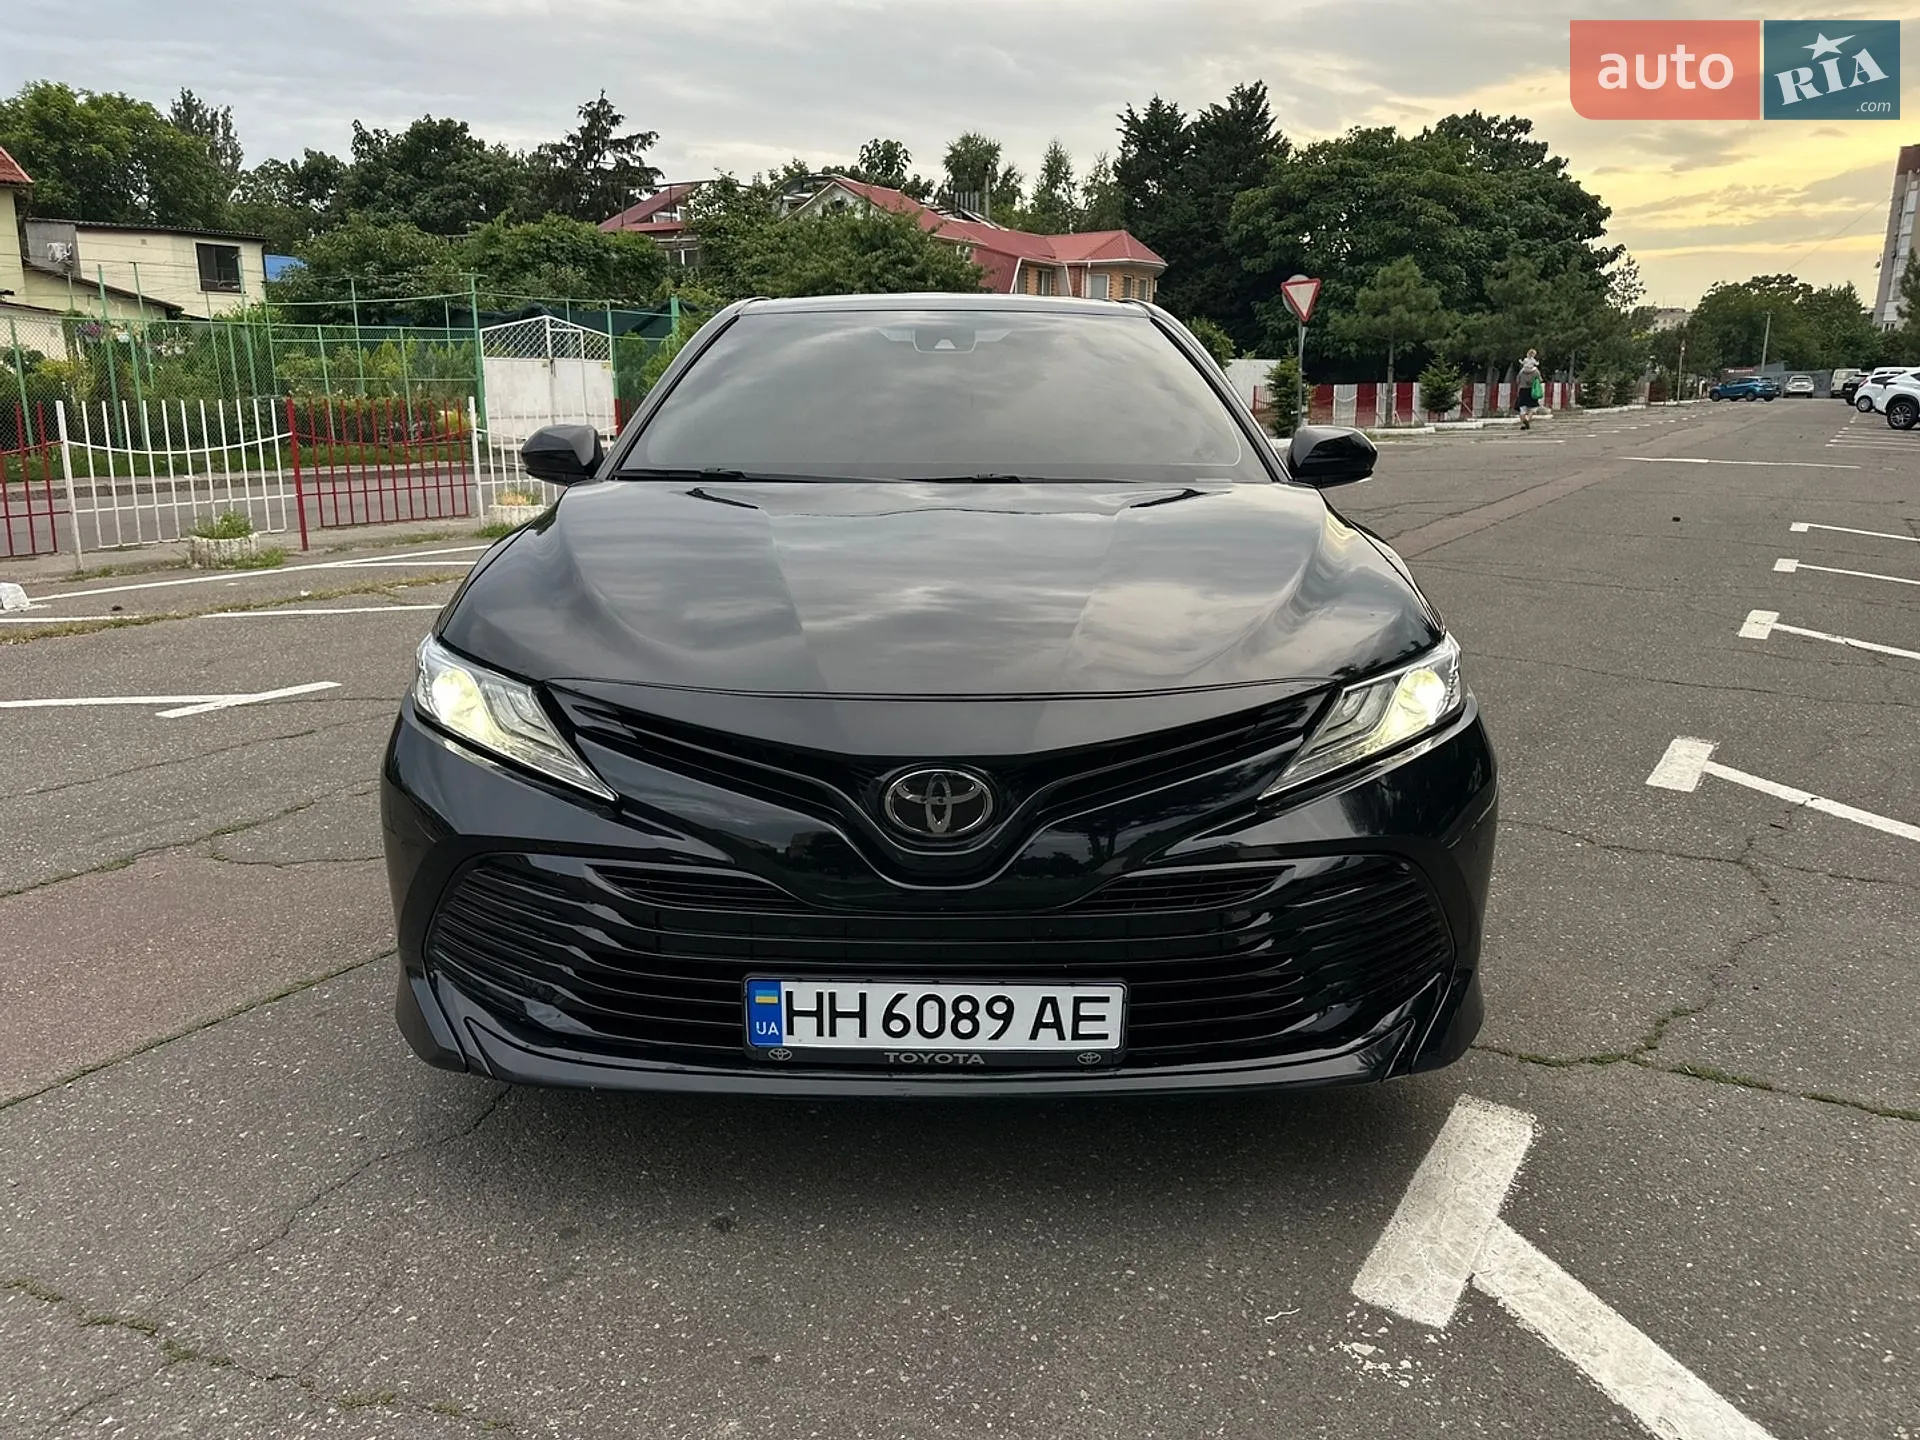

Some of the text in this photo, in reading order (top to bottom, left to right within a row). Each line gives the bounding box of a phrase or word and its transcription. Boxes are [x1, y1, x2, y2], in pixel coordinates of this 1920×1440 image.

[784, 991, 1110, 1041] HH 6089 AE
[756, 1021, 779, 1036] UA
[884, 1052, 985, 1065] TOYOTA
